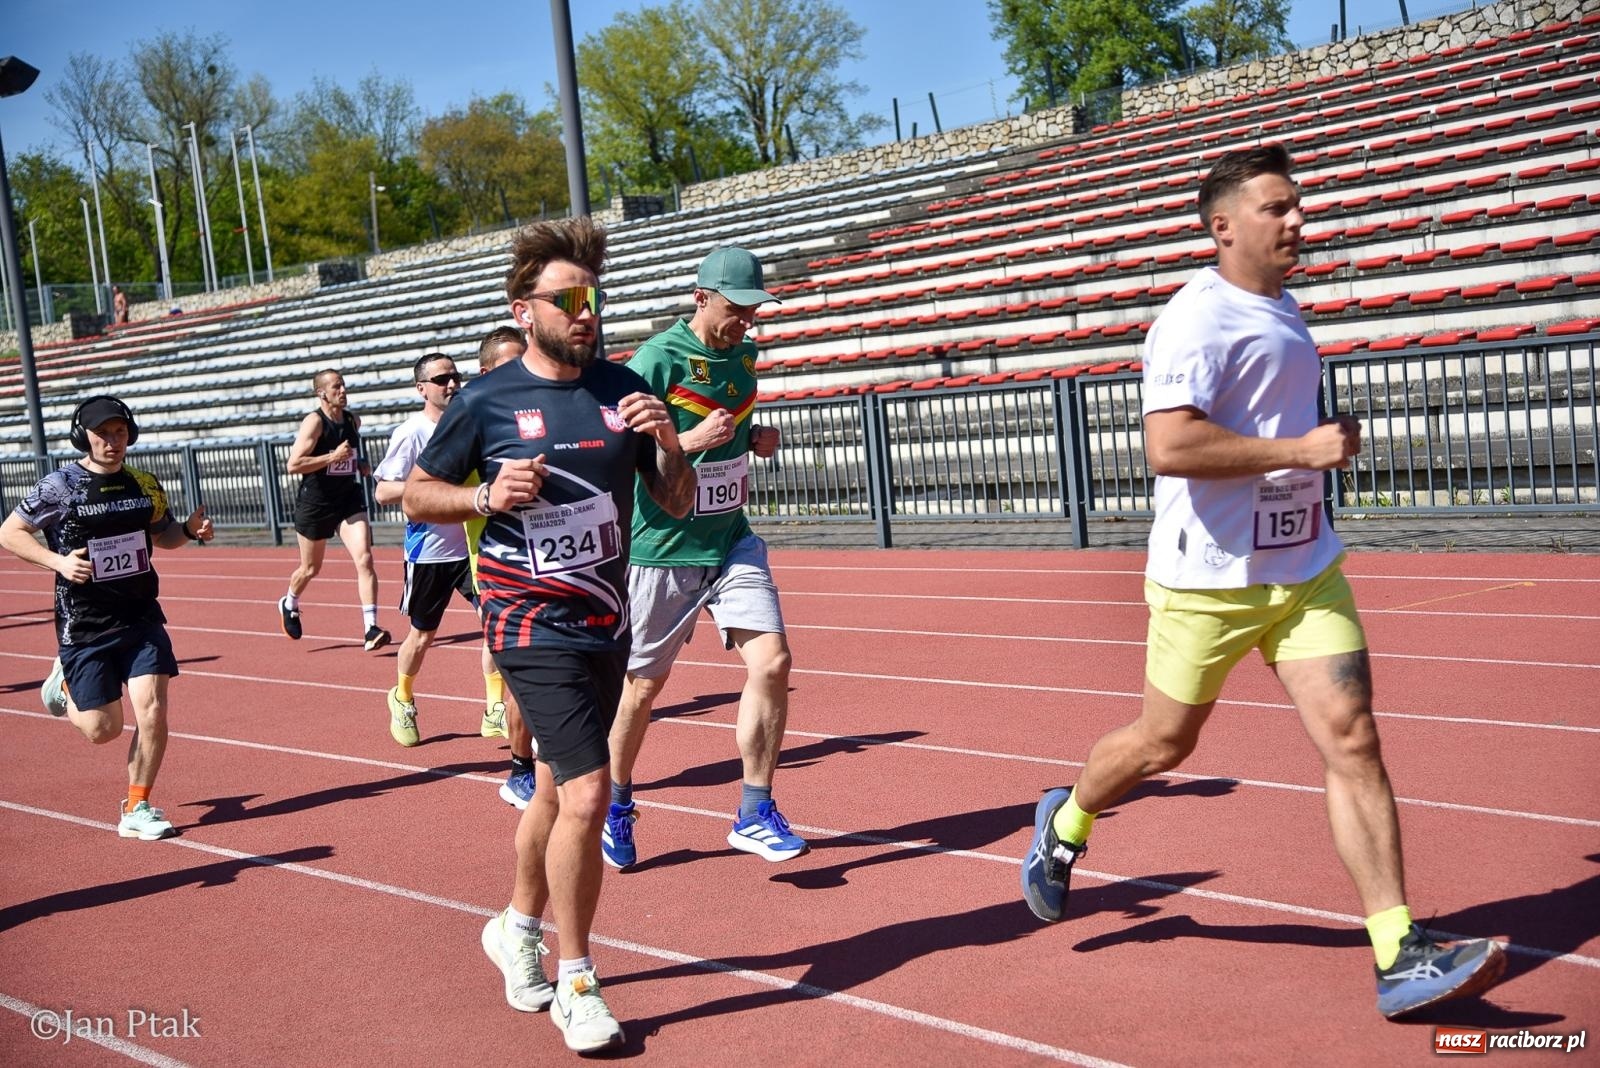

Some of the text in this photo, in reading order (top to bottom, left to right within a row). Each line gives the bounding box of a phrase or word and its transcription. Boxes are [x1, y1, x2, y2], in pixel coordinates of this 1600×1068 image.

[706, 482, 738, 505] 190
[529, 513, 544, 522] XVIII
[545, 511, 560, 519] BIEG
[561, 509, 573, 517] BEZ
[530, 518, 566, 530] 3MAJA2026
[1269, 508, 1307, 538] 157
[540, 530, 597, 563] 234
[102, 553, 133, 572] 212
